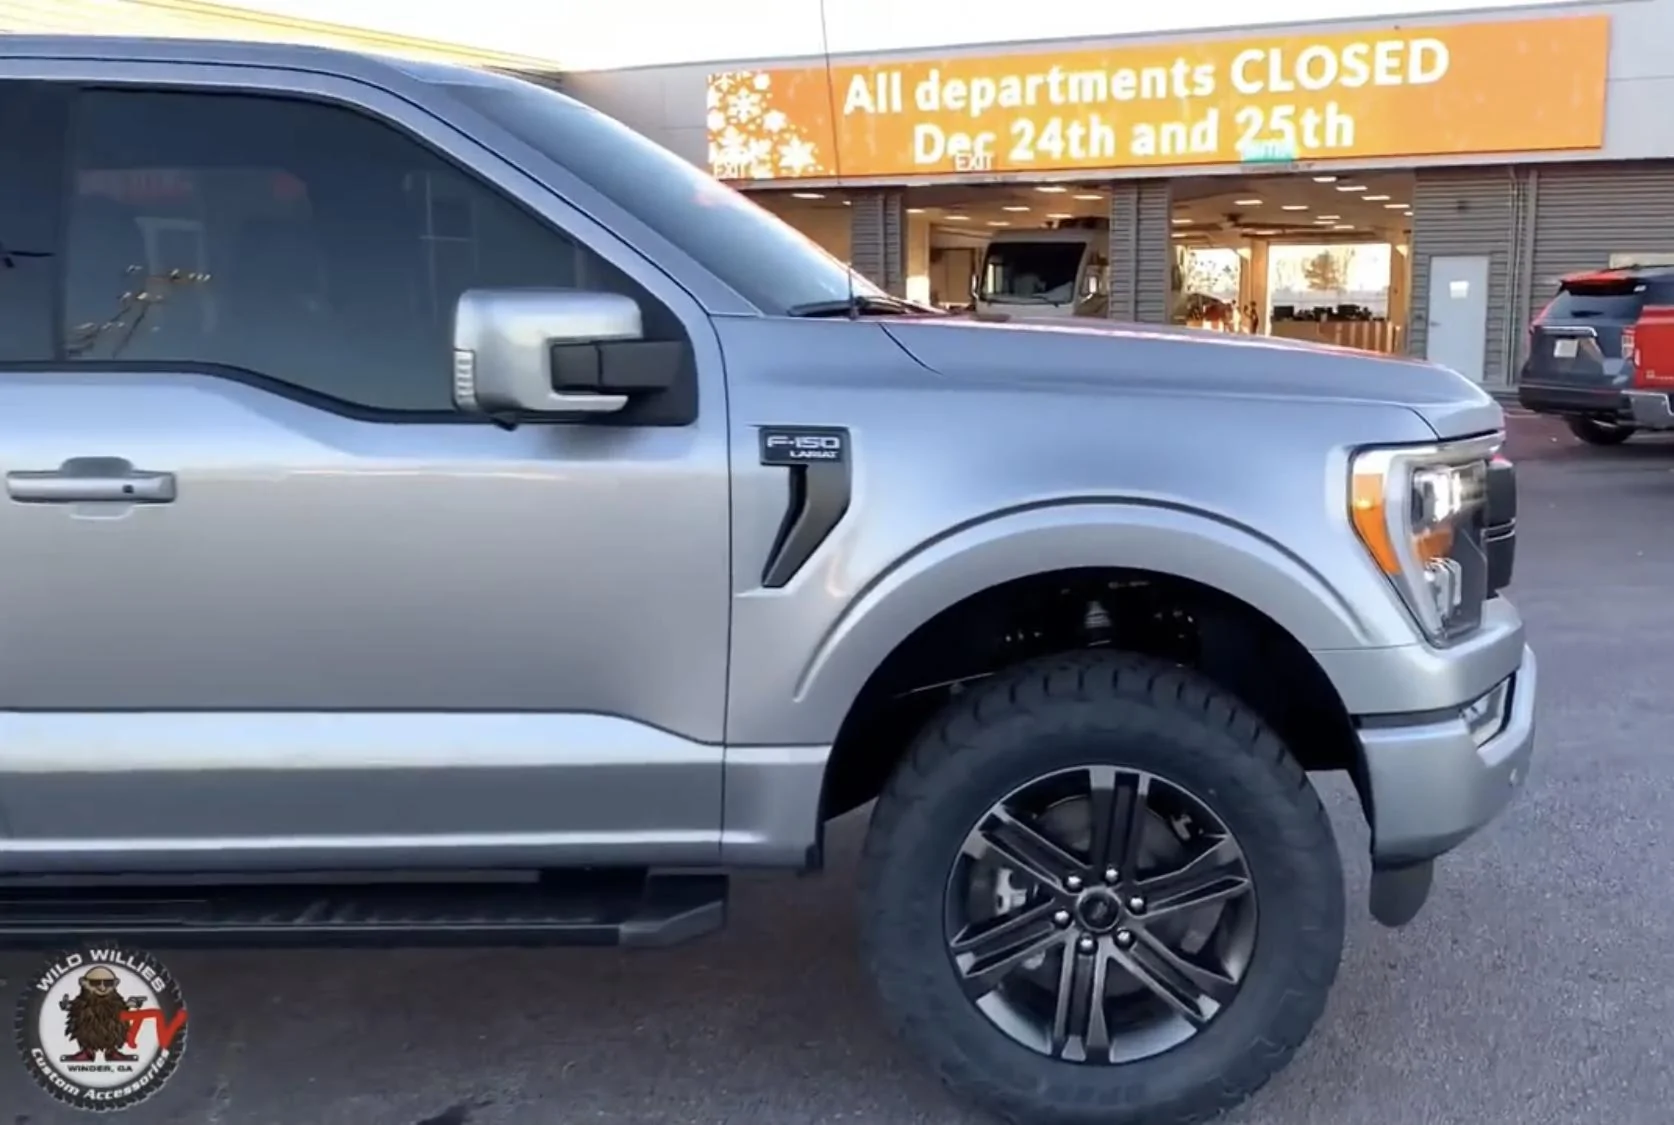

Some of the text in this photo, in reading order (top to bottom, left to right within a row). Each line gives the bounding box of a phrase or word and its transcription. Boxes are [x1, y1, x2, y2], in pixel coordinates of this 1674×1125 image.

[844, 38, 1450, 116] All departments CLOSED
[914, 122, 997, 165] Dec
[1010, 114, 1115, 162] 24th
[1131, 108, 1219, 156] and
[1235, 100, 1355, 154] 25th
[767, 435, 841, 449] F-150
